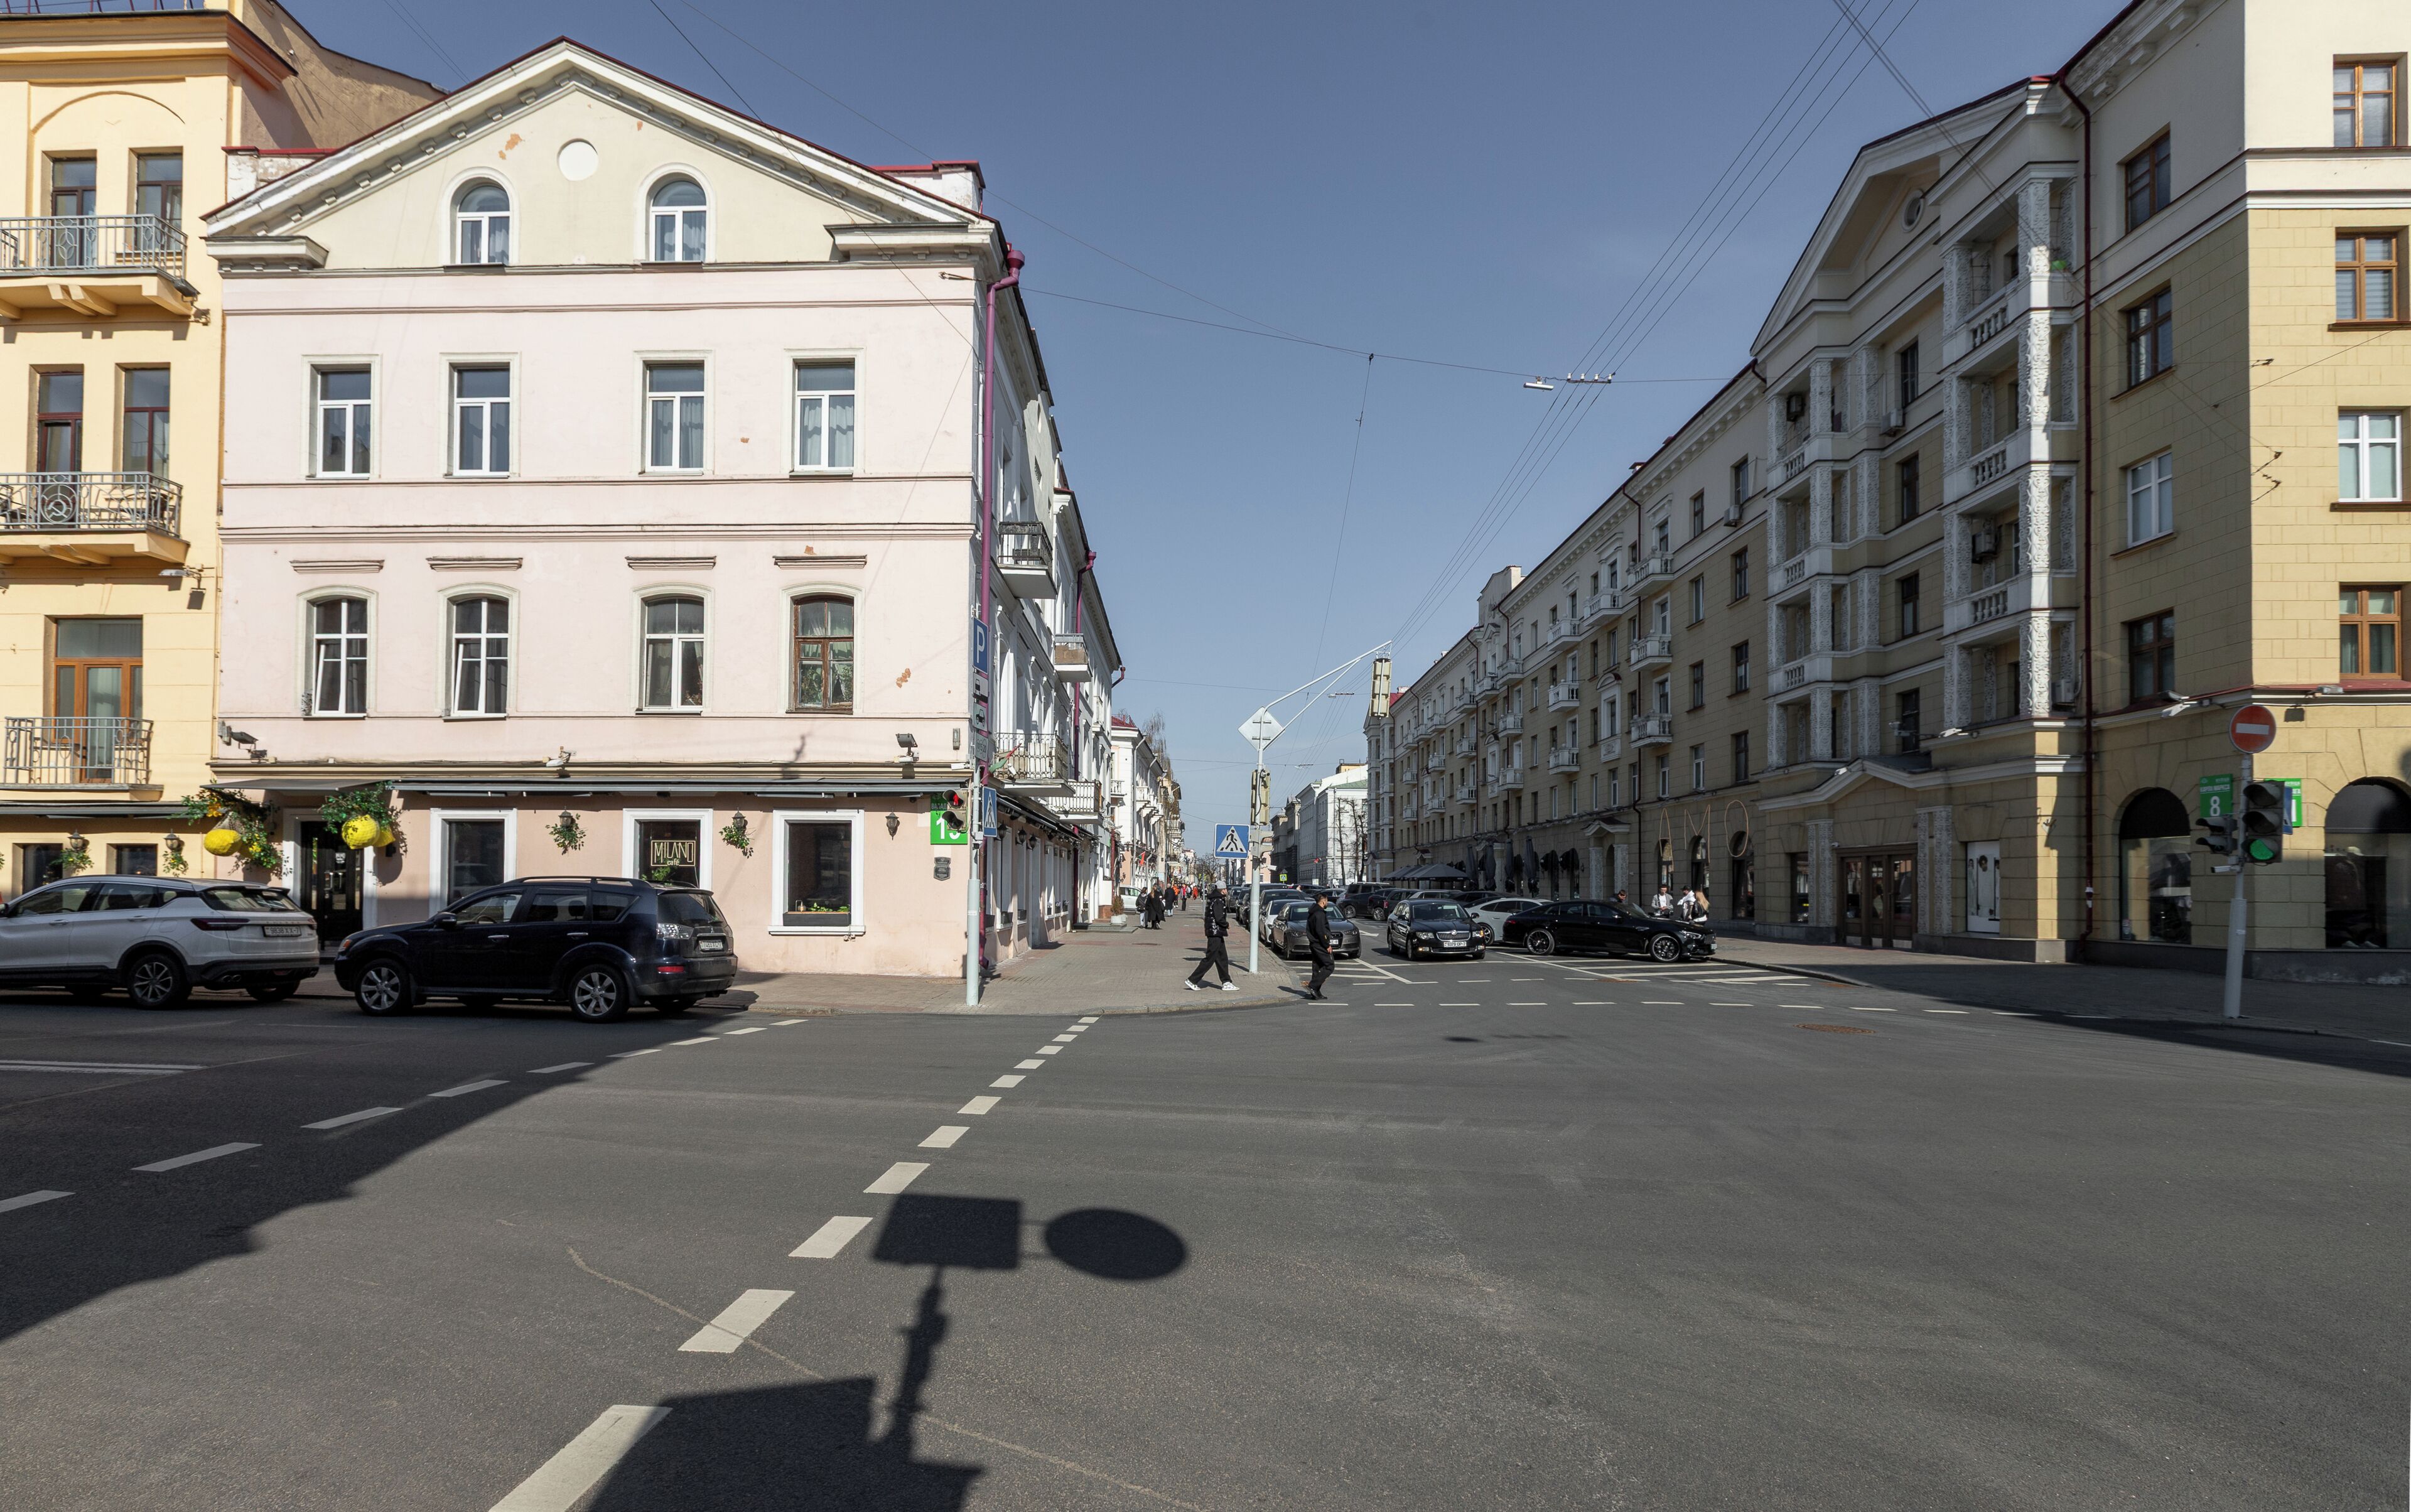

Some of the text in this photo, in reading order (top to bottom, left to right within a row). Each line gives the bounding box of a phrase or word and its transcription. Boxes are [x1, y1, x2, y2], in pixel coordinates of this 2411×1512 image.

[976, 625, 985, 664] P
[2210, 796, 2221, 816] 8
[654, 842, 694, 863] MILANO
